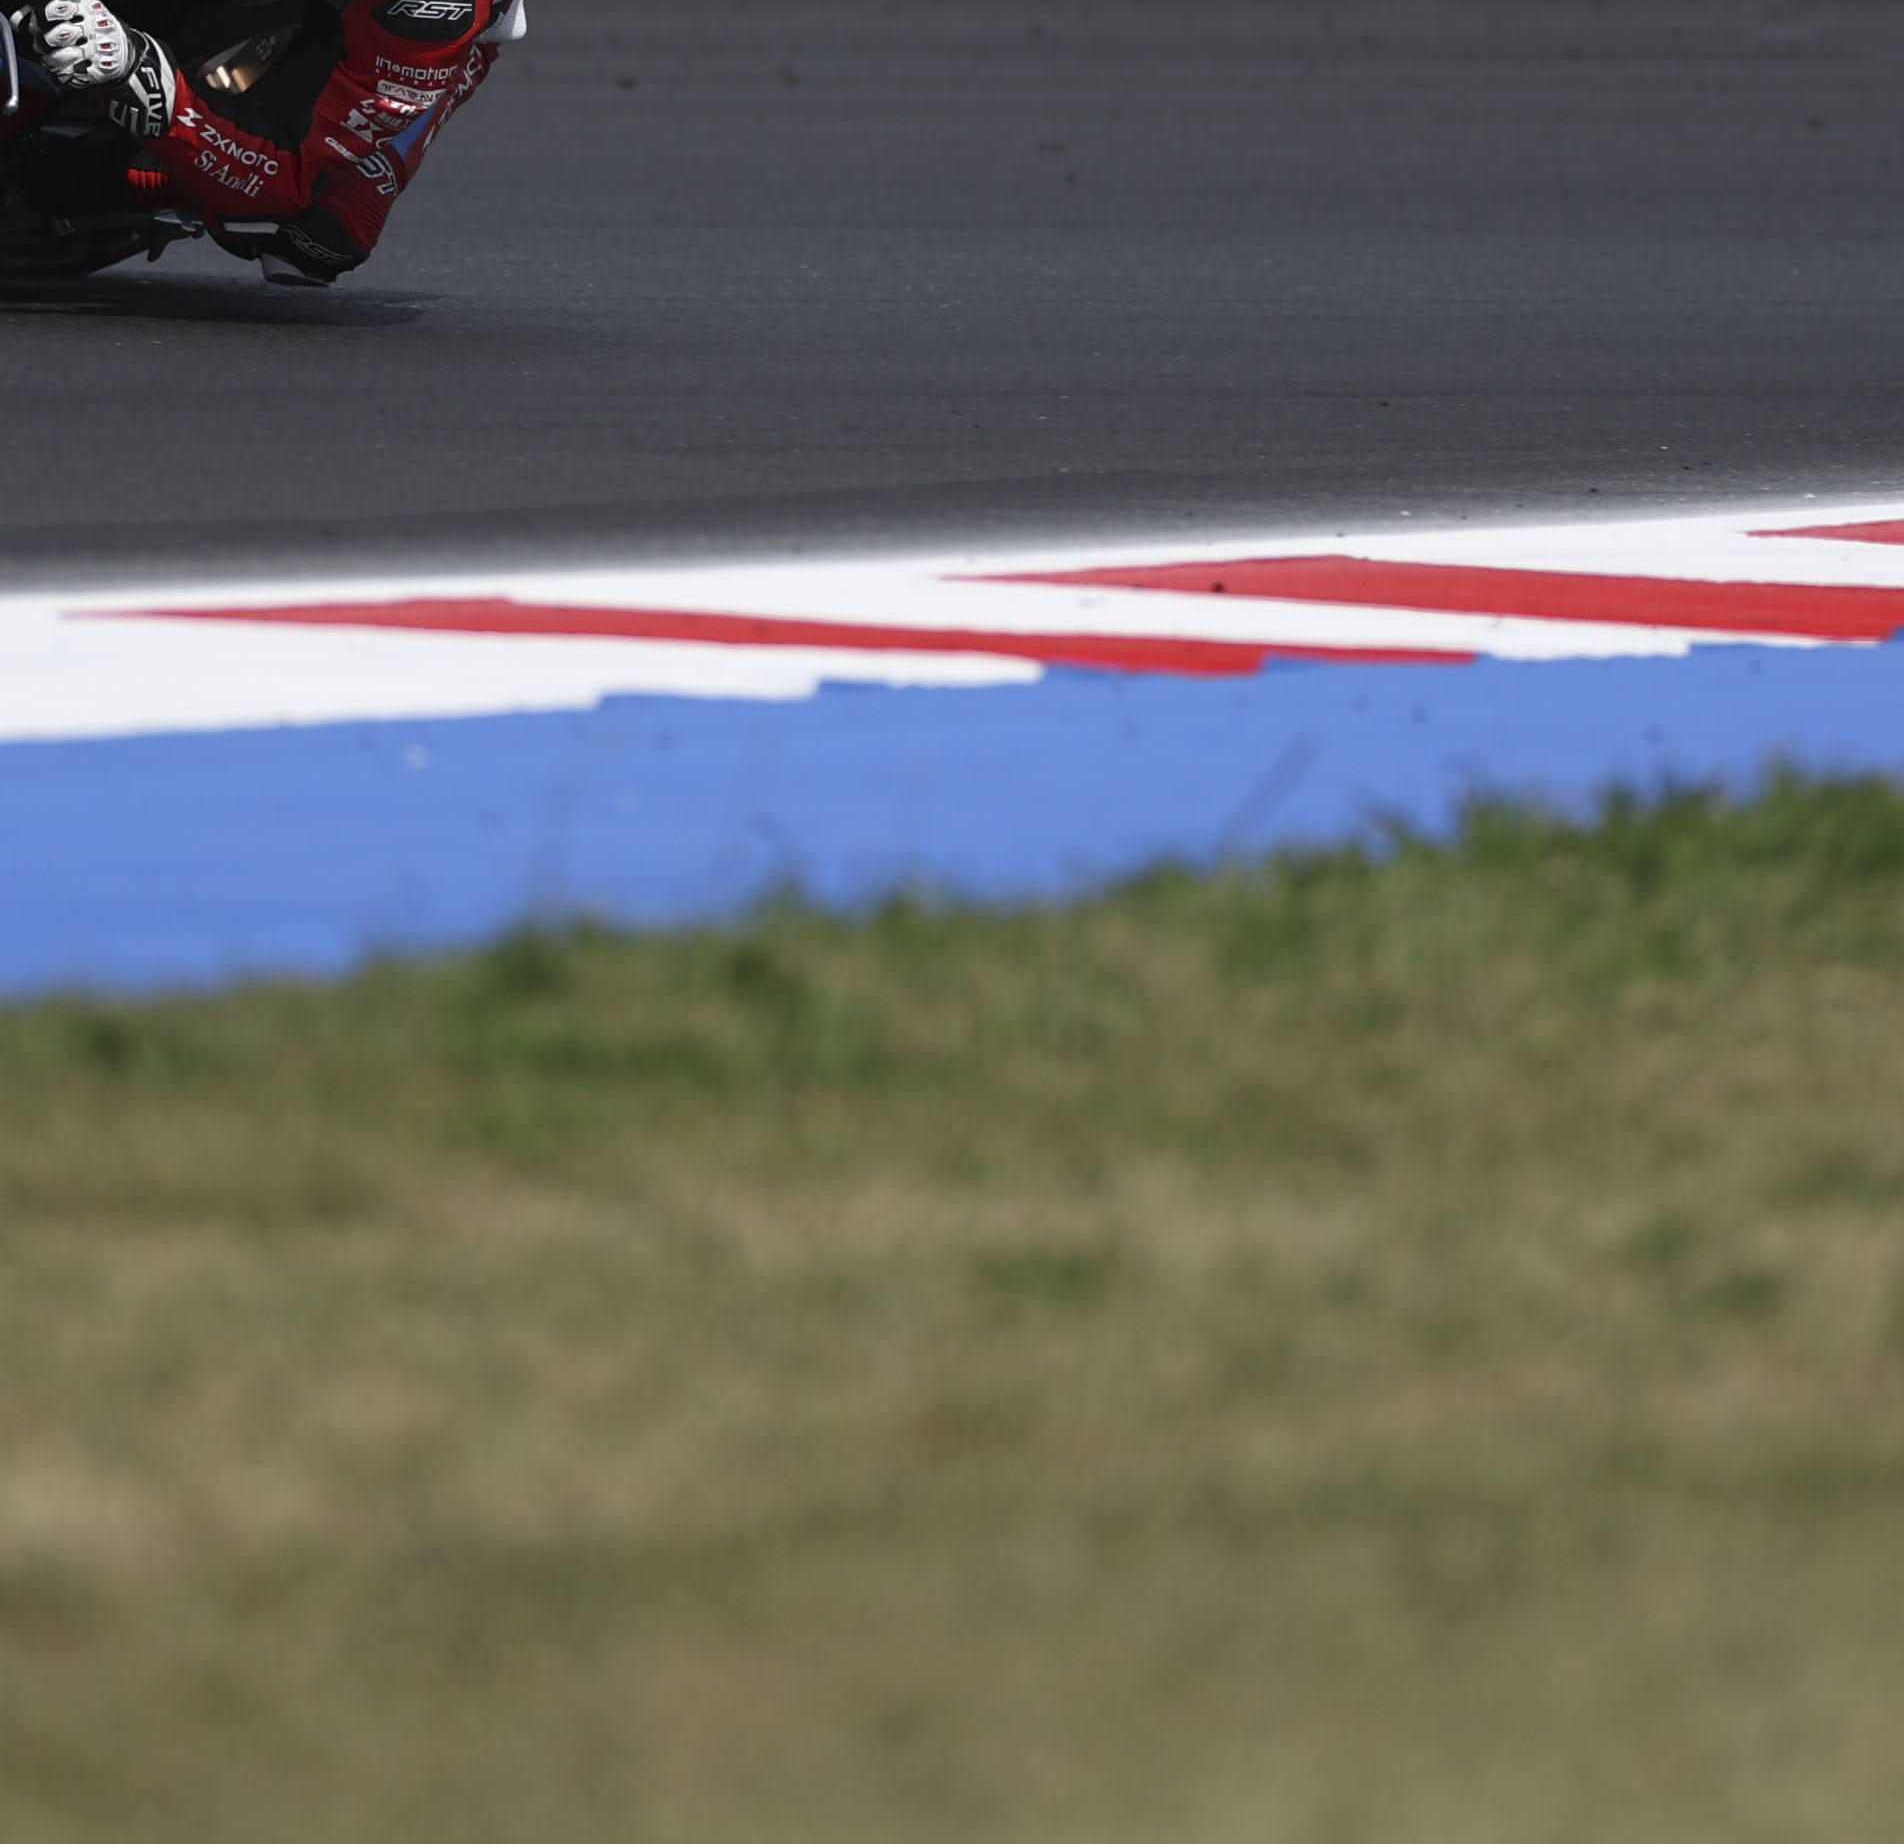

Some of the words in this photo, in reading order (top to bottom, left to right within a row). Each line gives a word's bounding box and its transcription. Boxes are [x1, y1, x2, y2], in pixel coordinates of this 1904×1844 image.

[387, 0, 473, 21] RST
[141, 66, 165, 138] FIVE
[200, 123, 280, 176] ZXMOTO
